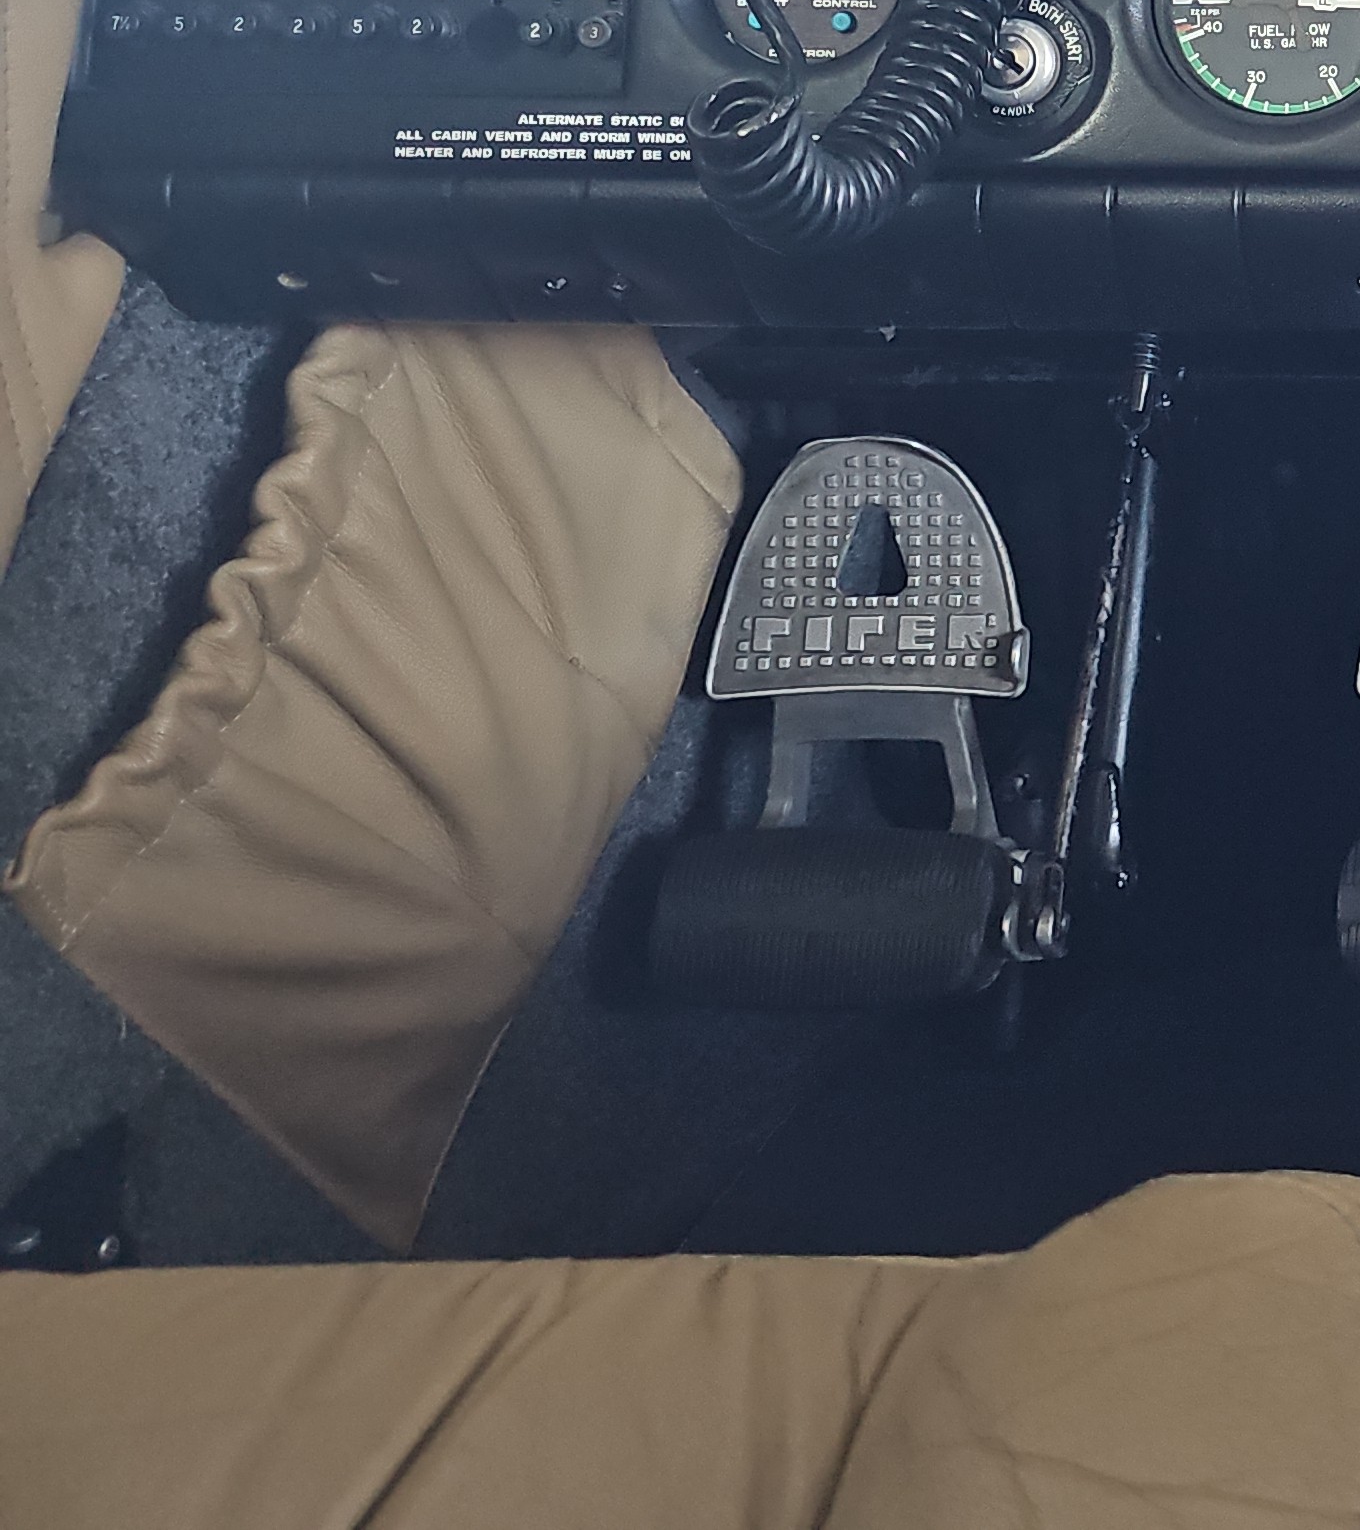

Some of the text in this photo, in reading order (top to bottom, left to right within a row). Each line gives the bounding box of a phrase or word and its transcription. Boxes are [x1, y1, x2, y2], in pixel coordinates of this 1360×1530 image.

[813, 0, 876, 9] CONTROL
[1249, 25, 1285, 37] FUEL
[1059, 21, 1084, 64] START
[518, 114, 662, 126] ALTERNATE STATIC
[396, 130, 630, 143] ALL CABIN VENTS AND STORM
[395, 148, 690, 161] HEATER AND DEFROSTER MUST BE ON
[753, 615, 987, 652] PIPER
